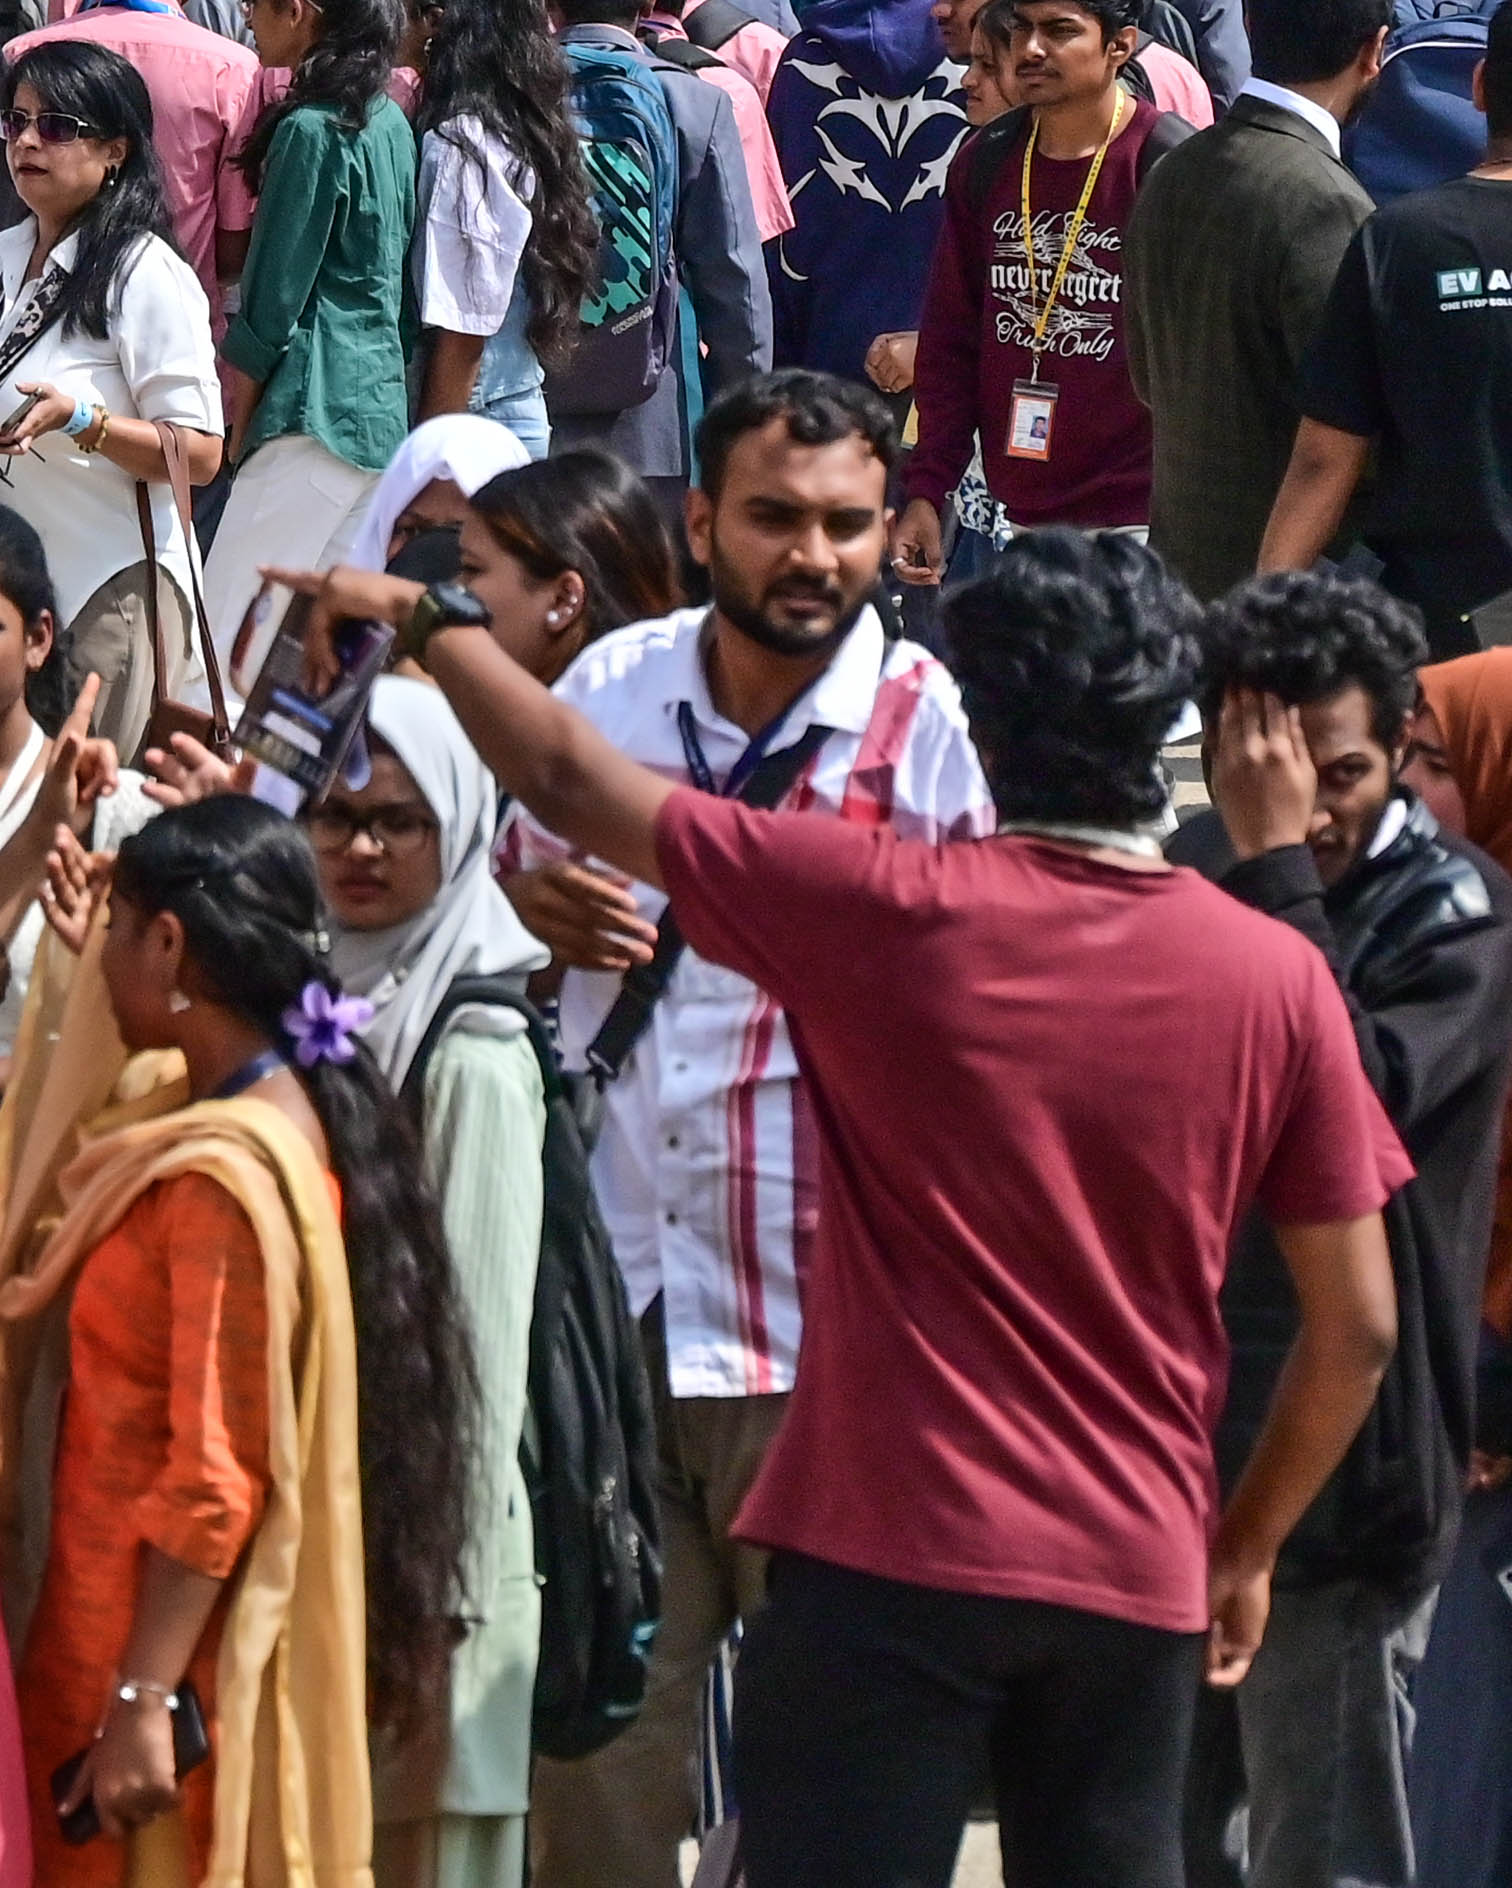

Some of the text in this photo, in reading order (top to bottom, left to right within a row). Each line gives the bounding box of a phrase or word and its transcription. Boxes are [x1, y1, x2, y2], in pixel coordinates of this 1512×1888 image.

[1441, 272, 1479, 295] EV
[1440, 301, 1462, 312] ONE
[1462, 298, 1489, 310] STOP
[1059, 326, 1116, 361] Only
